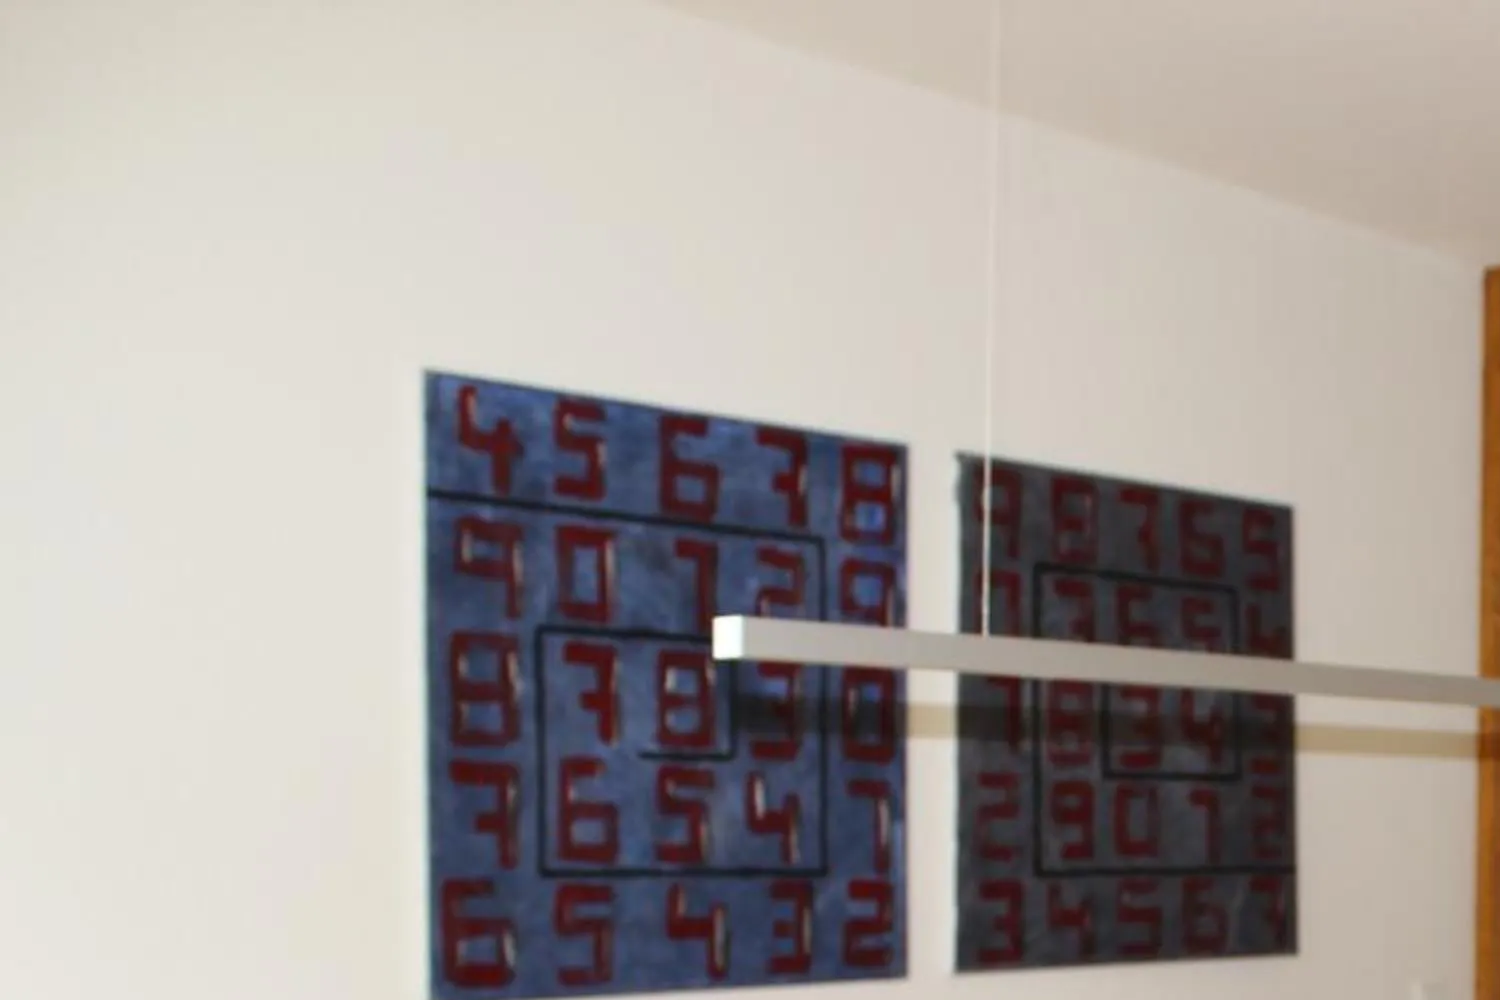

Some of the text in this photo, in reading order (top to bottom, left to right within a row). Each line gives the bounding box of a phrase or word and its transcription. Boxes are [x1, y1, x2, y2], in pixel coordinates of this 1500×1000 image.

[457, 386, 899, 545] 4 5 6 7 8
[453, 515, 521, 619] 9
[555, 524, 615, 623] 0
[975, 467, 1279, 590] 9 8 7 6 5
[449, 631, 521, 748] 8
[562, 641, 619, 745] 7
[655, 650, 715, 748] 8
[748, 659, 800, 760] 3
[449, 760, 518, 869] 7
[559, 758, 619, 863] 6
[656, 767, 715, 862] 5
[746, 771, 797, 863] 4
[976, 773, 1018, 861] 2
[1049, 780, 1095, 861] 9
[1112, 783, 1160, 857] 0
[441, 878, 893, 987] 6 5 4 3 2
[977, 880, 1024, 964] 3
[1046, 884, 1091, 957] 4
[1116, 881, 1162, 955] 5
[1182, 878, 1227, 955] 6
